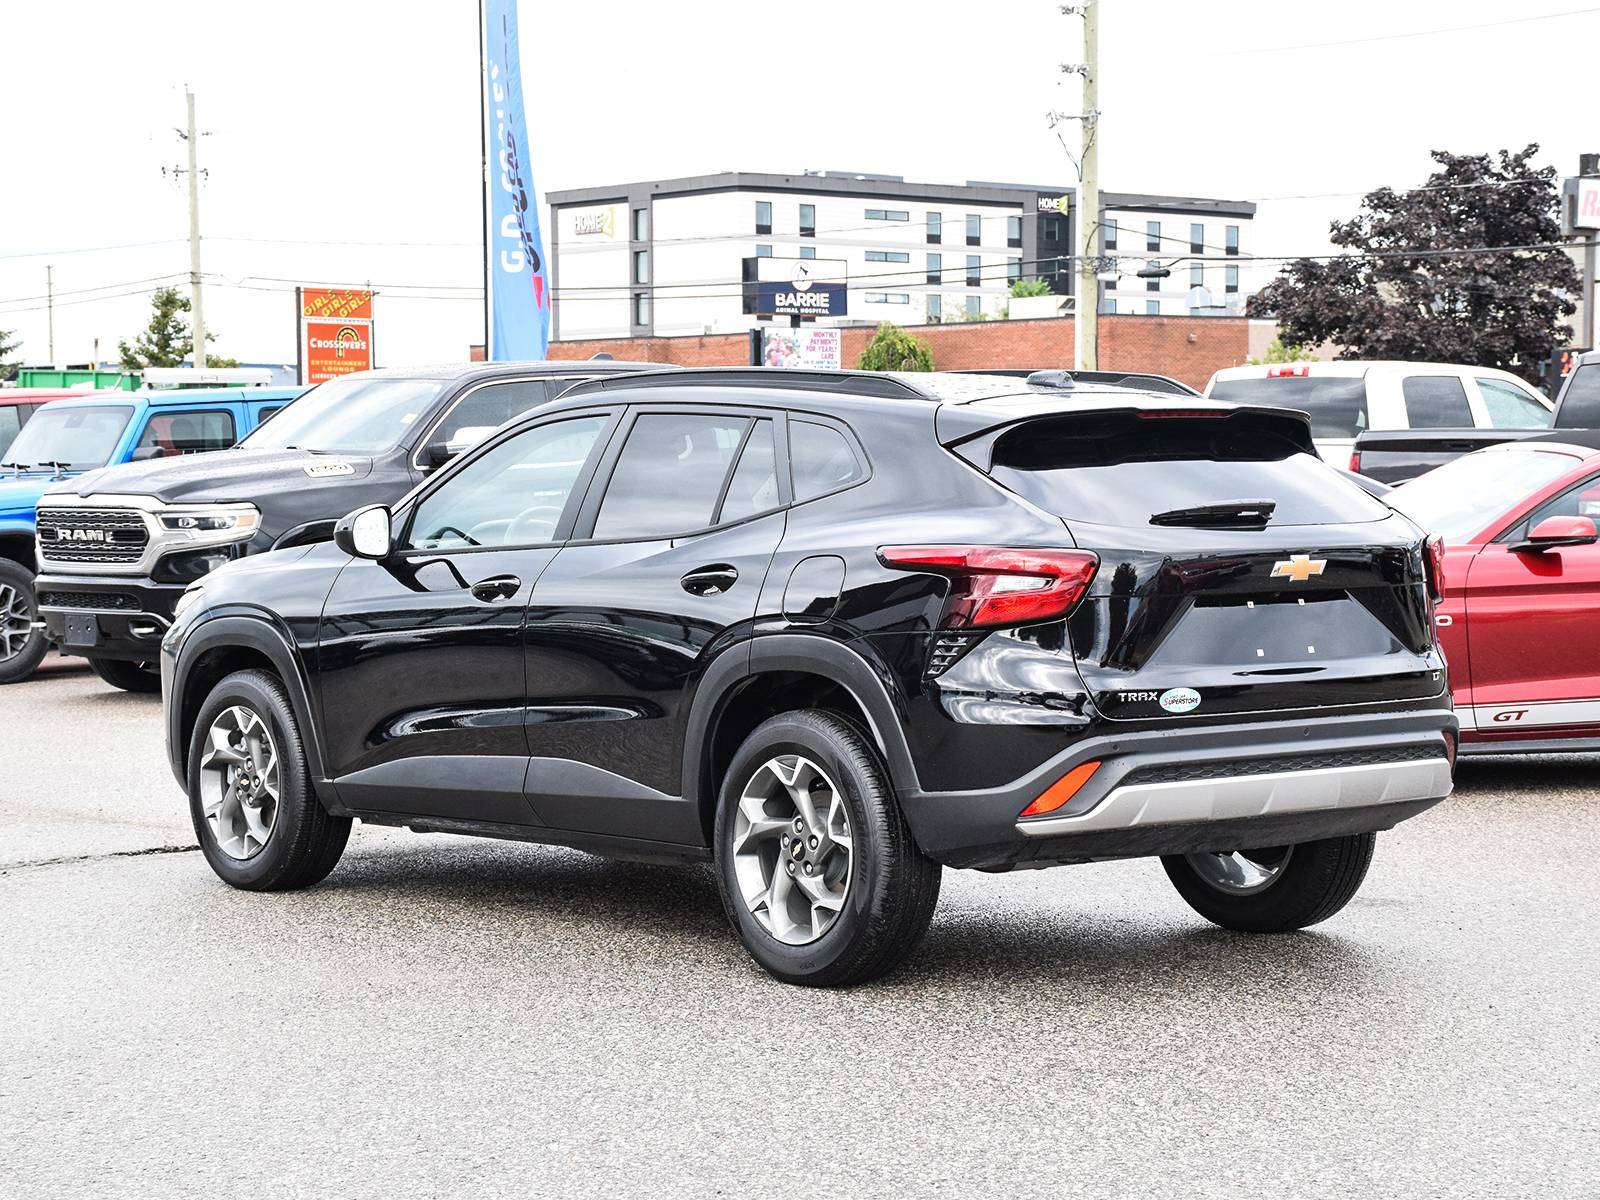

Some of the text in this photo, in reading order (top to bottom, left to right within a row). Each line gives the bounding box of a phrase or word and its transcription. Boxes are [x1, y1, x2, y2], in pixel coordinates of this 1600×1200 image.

[1583, 190, 1600, 216] R
[304, 289, 337, 316] GIRLS
[322, 290, 354, 317] GIRLS
[339, 290, 371, 318] GIRLS
[775, 293, 829, 307] BARRIE
[58, 529, 104, 541] RAM
[1118, 692, 1158, 702] TRAX
[1493, 710, 1529, 722] GT
